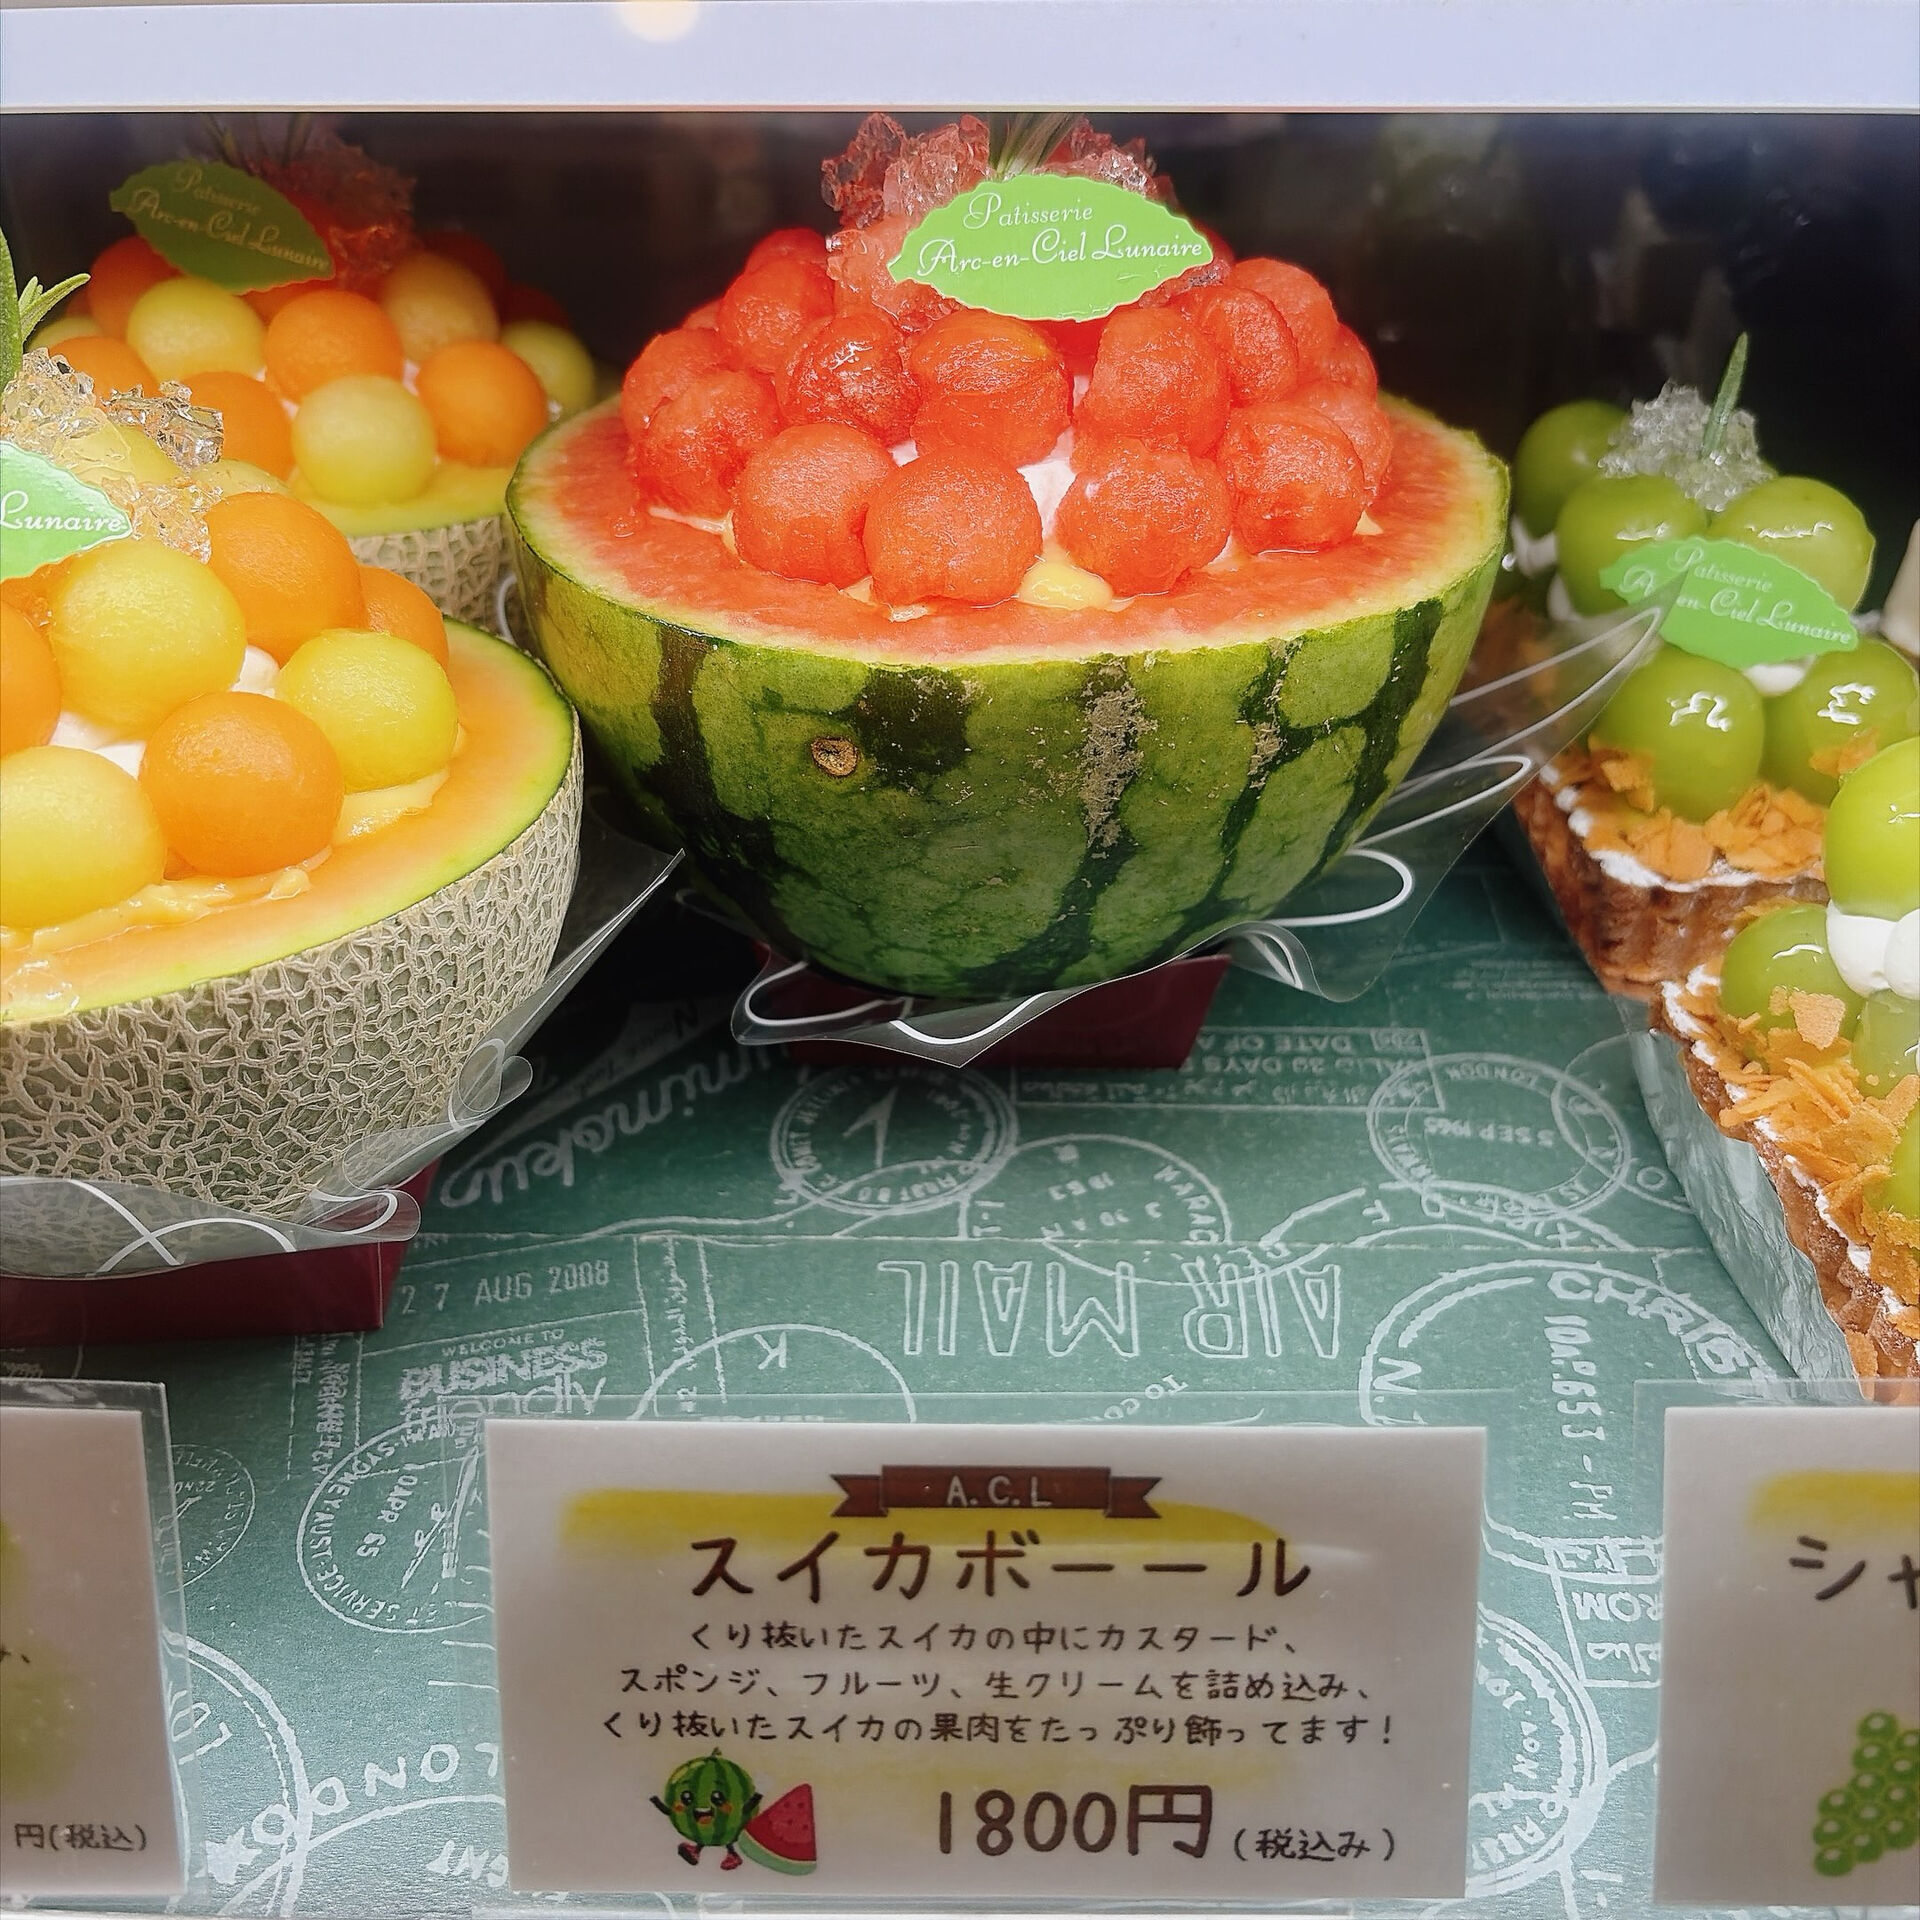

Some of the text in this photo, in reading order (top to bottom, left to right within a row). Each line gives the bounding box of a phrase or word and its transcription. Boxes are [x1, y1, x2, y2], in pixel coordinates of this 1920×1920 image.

[963, 192, 1094, 230] Patisserie
[917, 224, 1203, 277] Arc-en-Ciel Lunaire
[0, 490, 127, 531] Lunaire
[1667, 544, 1774, 593] Patisserie
[1757, 601, 1850, 644] Lunaire
[474, 1271, 533, 1307] AUG
[877, 1260, 1342, 1360] AIR MAIL
[946, 1475, 1052, 1508] A.C.L
[690, 1528, 1312, 1604] スイカボーール
[691, 1620, 1299, 1655] くり抜いたスイカの中にカスタード、
[938, 1784, 1214, 1859] 1800円
